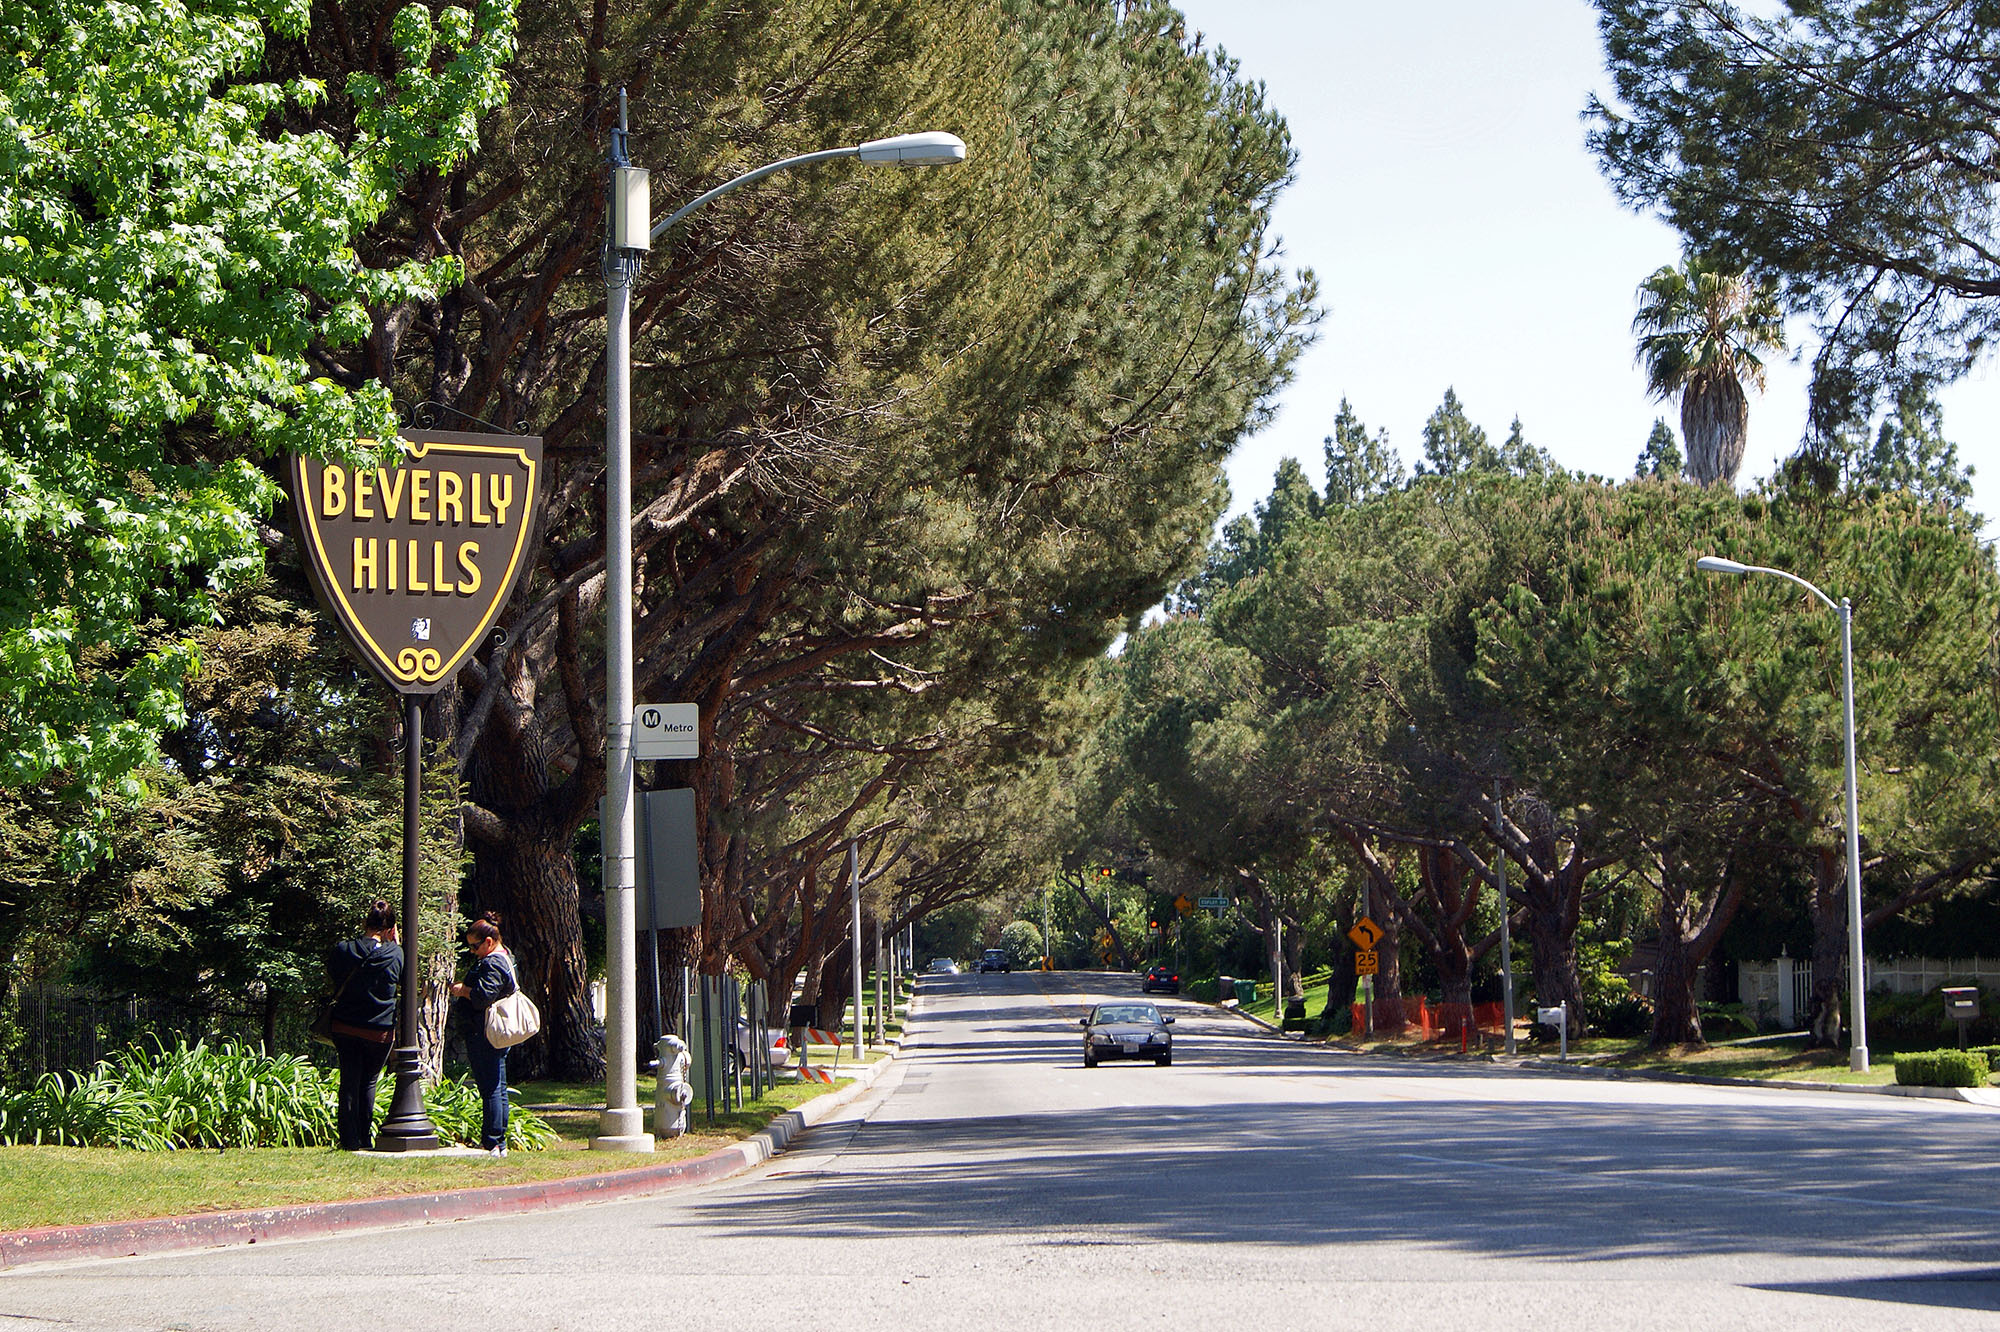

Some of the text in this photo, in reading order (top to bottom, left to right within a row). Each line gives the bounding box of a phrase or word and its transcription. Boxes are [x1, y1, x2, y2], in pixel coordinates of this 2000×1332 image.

[323, 465, 513, 524] BEVERLY
[353, 537, 482, 594] HILLS
[664, 724, 694, 732] Metro
[1358, 953, 1376, 966] 25
